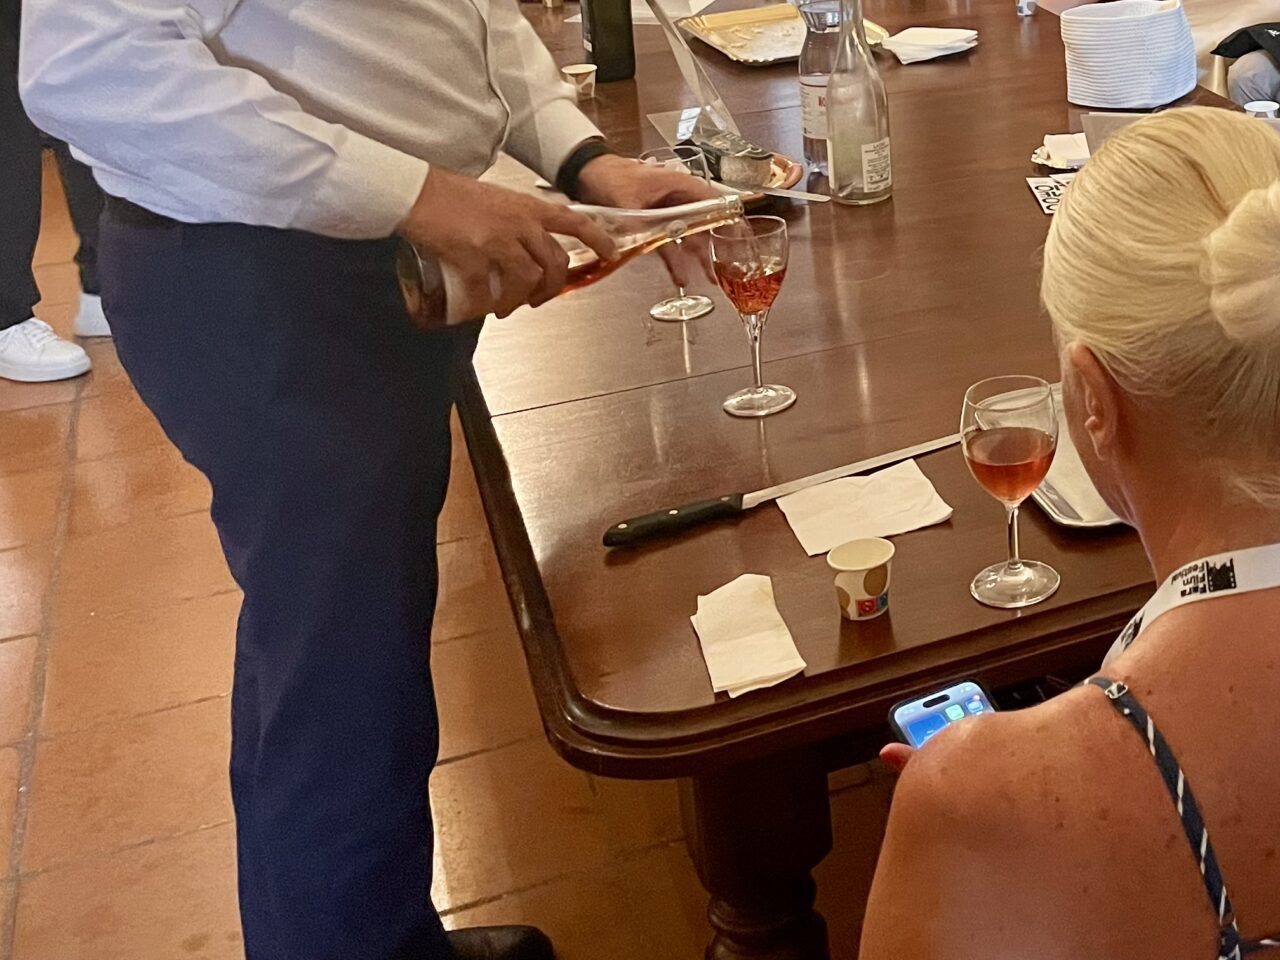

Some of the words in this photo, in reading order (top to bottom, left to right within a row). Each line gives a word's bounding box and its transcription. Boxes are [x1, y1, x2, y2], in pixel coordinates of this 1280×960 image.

[1170, 562, 1205, 585] Festival
[1182, 573, 1205, 587] Film
[1180, 583, 1207, 597] Fara
